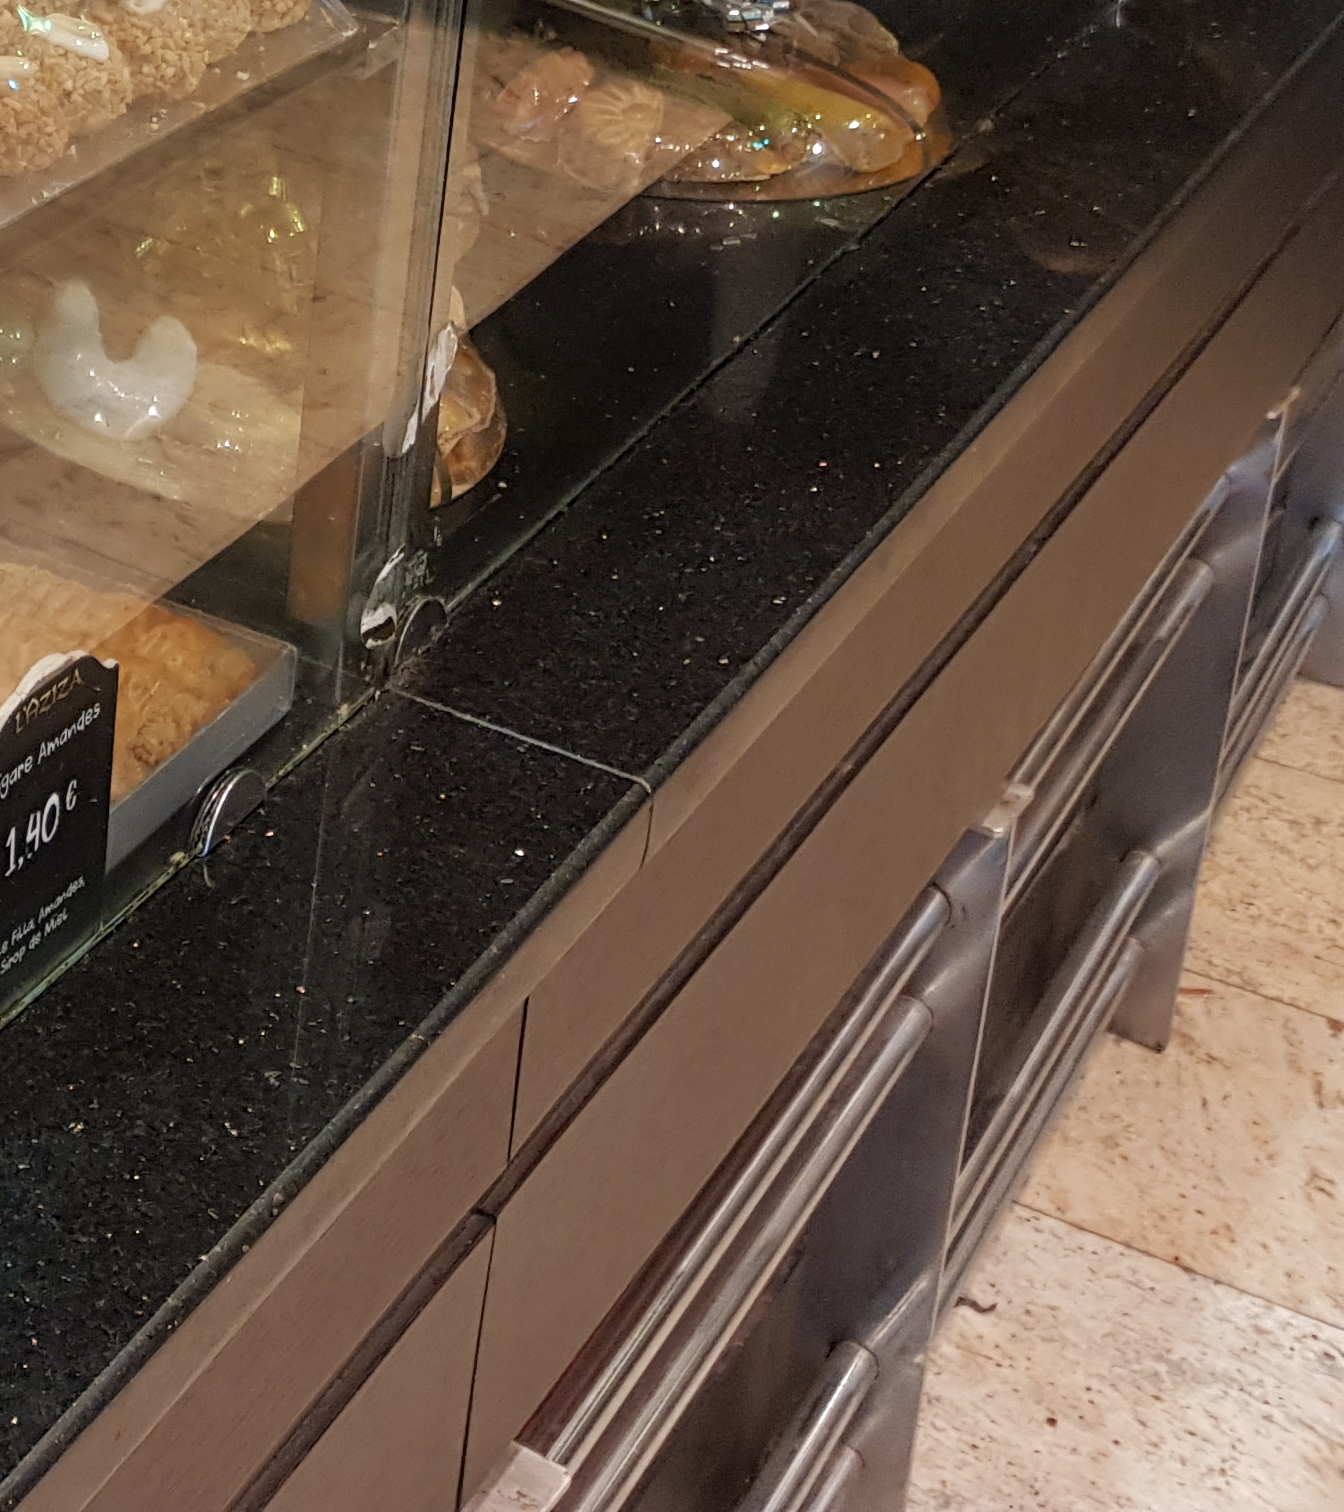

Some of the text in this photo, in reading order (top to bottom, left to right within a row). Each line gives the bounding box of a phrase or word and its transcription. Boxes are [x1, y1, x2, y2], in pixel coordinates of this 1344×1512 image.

[14, 668, 85, 735] L'AZIZA
[37, 702, 102, 766] Amandes
[65, 779, 78, 812] €
[38, 875, 86, 924] Amandes
